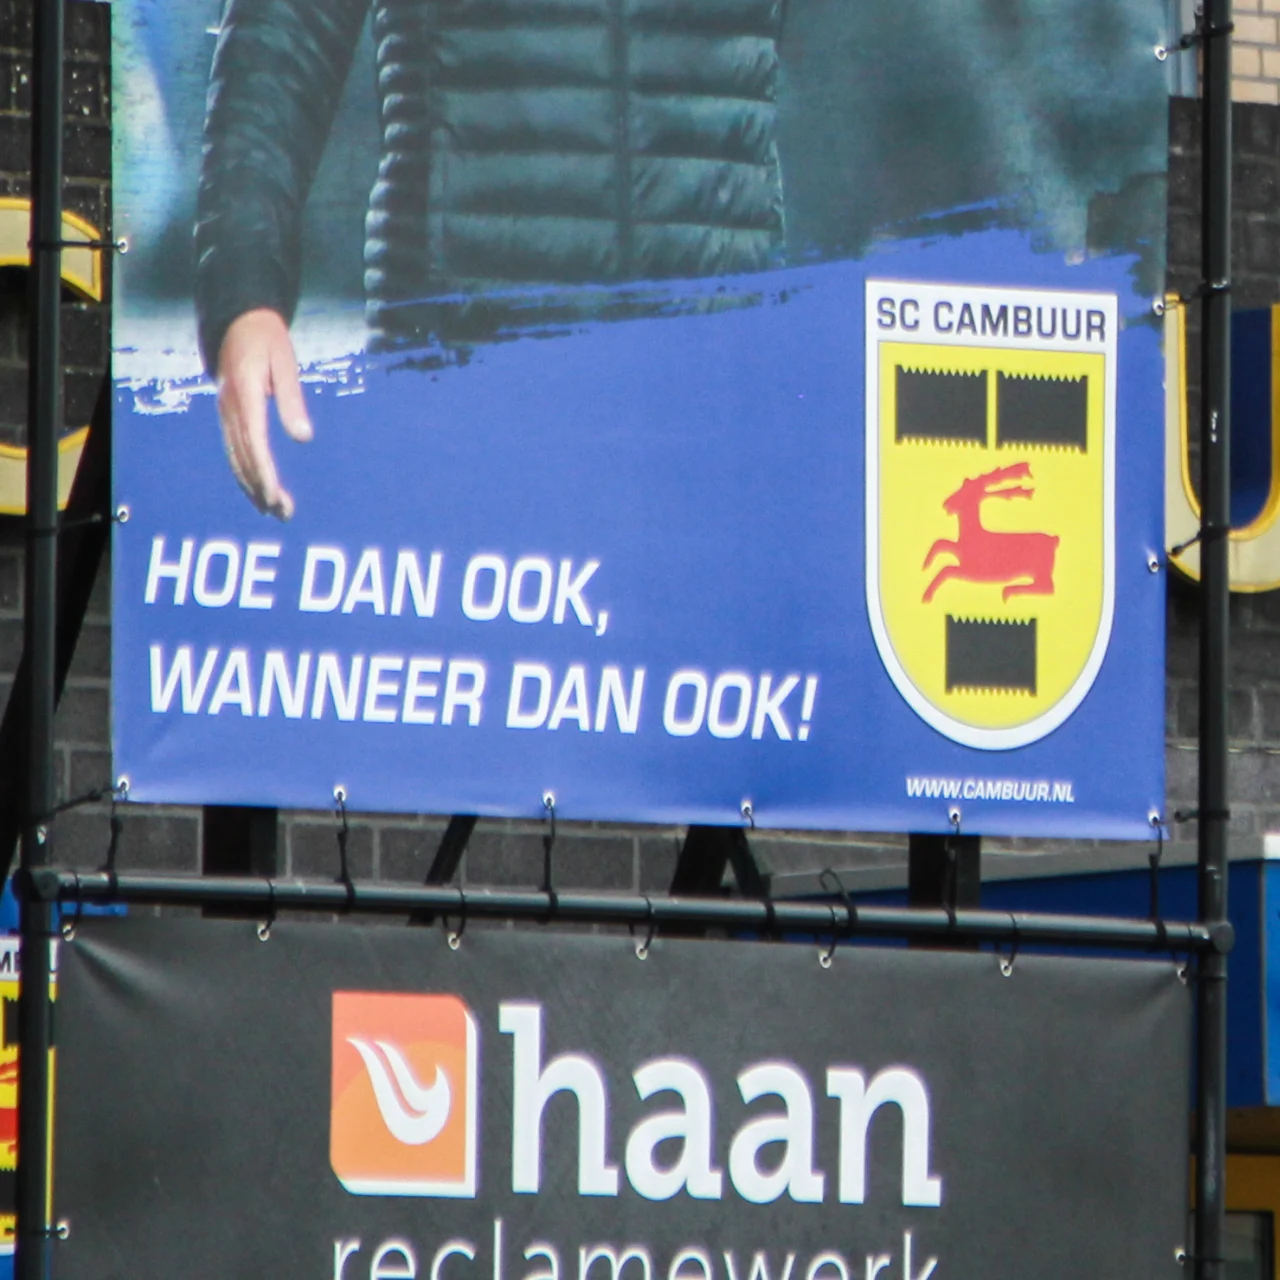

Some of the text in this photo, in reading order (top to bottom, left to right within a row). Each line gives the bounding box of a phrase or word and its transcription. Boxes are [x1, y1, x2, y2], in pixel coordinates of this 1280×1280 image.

[877, 297, 1107, 342] SC CAMBUUR
[145, 535, 610, 637] HOE DAN OOK,
[148, 643, 819, 742] WANNEER DAN OOK!
[905, 776, 1076, 803] WWW.CAMBUUR.NL
[498, 1001, 943, 1207] haan
